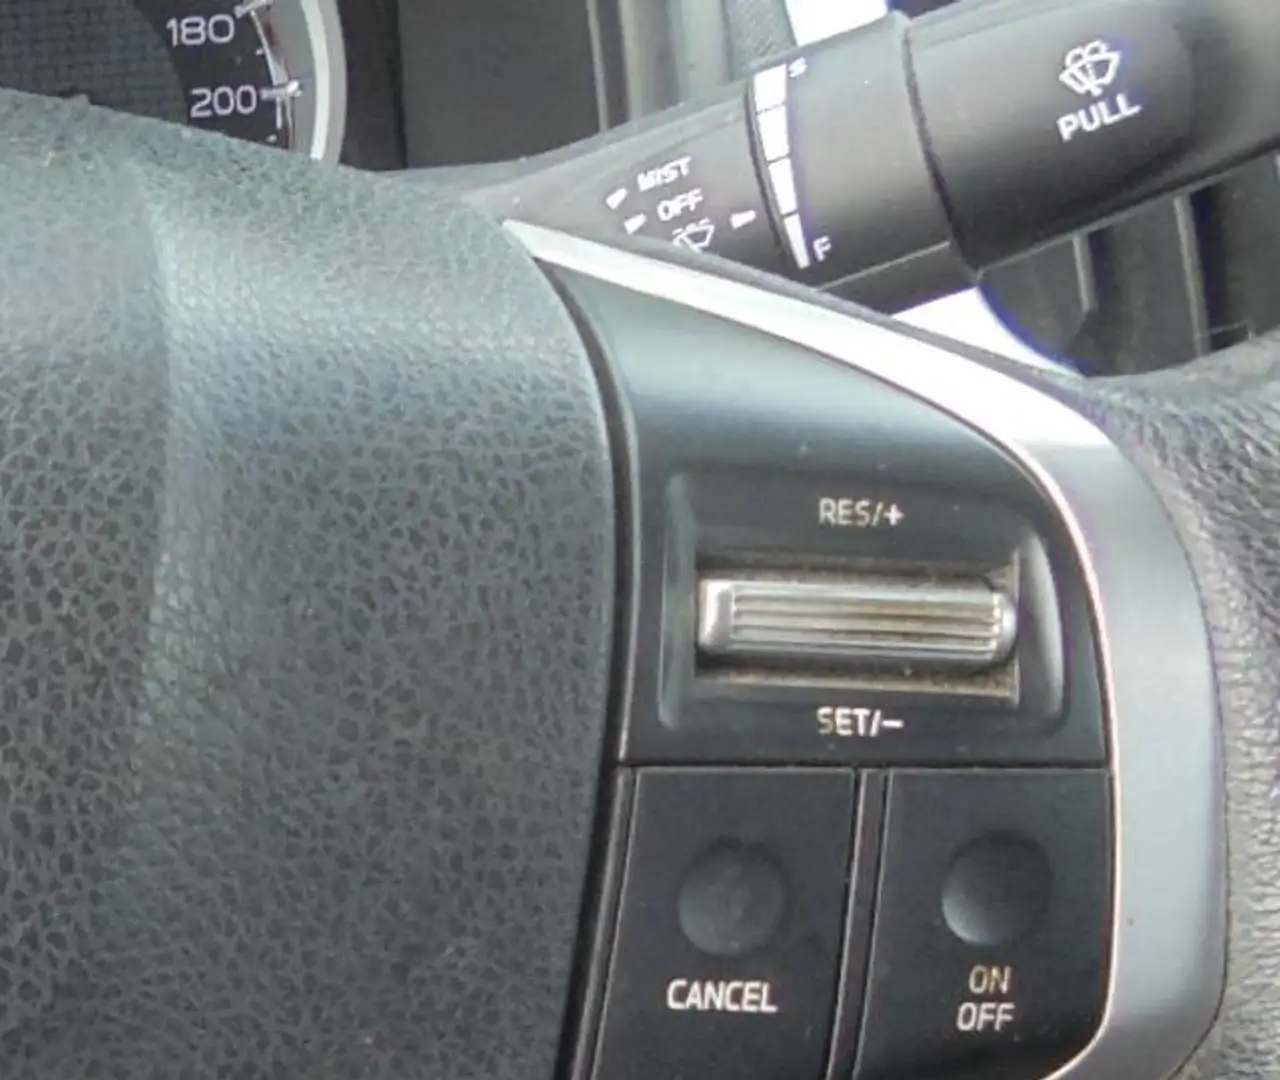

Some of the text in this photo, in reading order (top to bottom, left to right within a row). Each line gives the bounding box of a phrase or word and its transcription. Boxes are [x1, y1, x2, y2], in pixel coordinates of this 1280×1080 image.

[166, 14, 236, 47] 180
[190, 84, 258, 118] 200
[1056, 92, 1143, 142] PULL
[636, 155, 692, 192] MIST
[656, 187, 704, 222] OFF
[812, 234, 832, 263] F
[819, 497, 905, 527] RES/+
[968, 964, 1012, 994] ON
[666, 979, 778, 1013] CANCEL
[956, 1001, 1016, 1032] OFF
